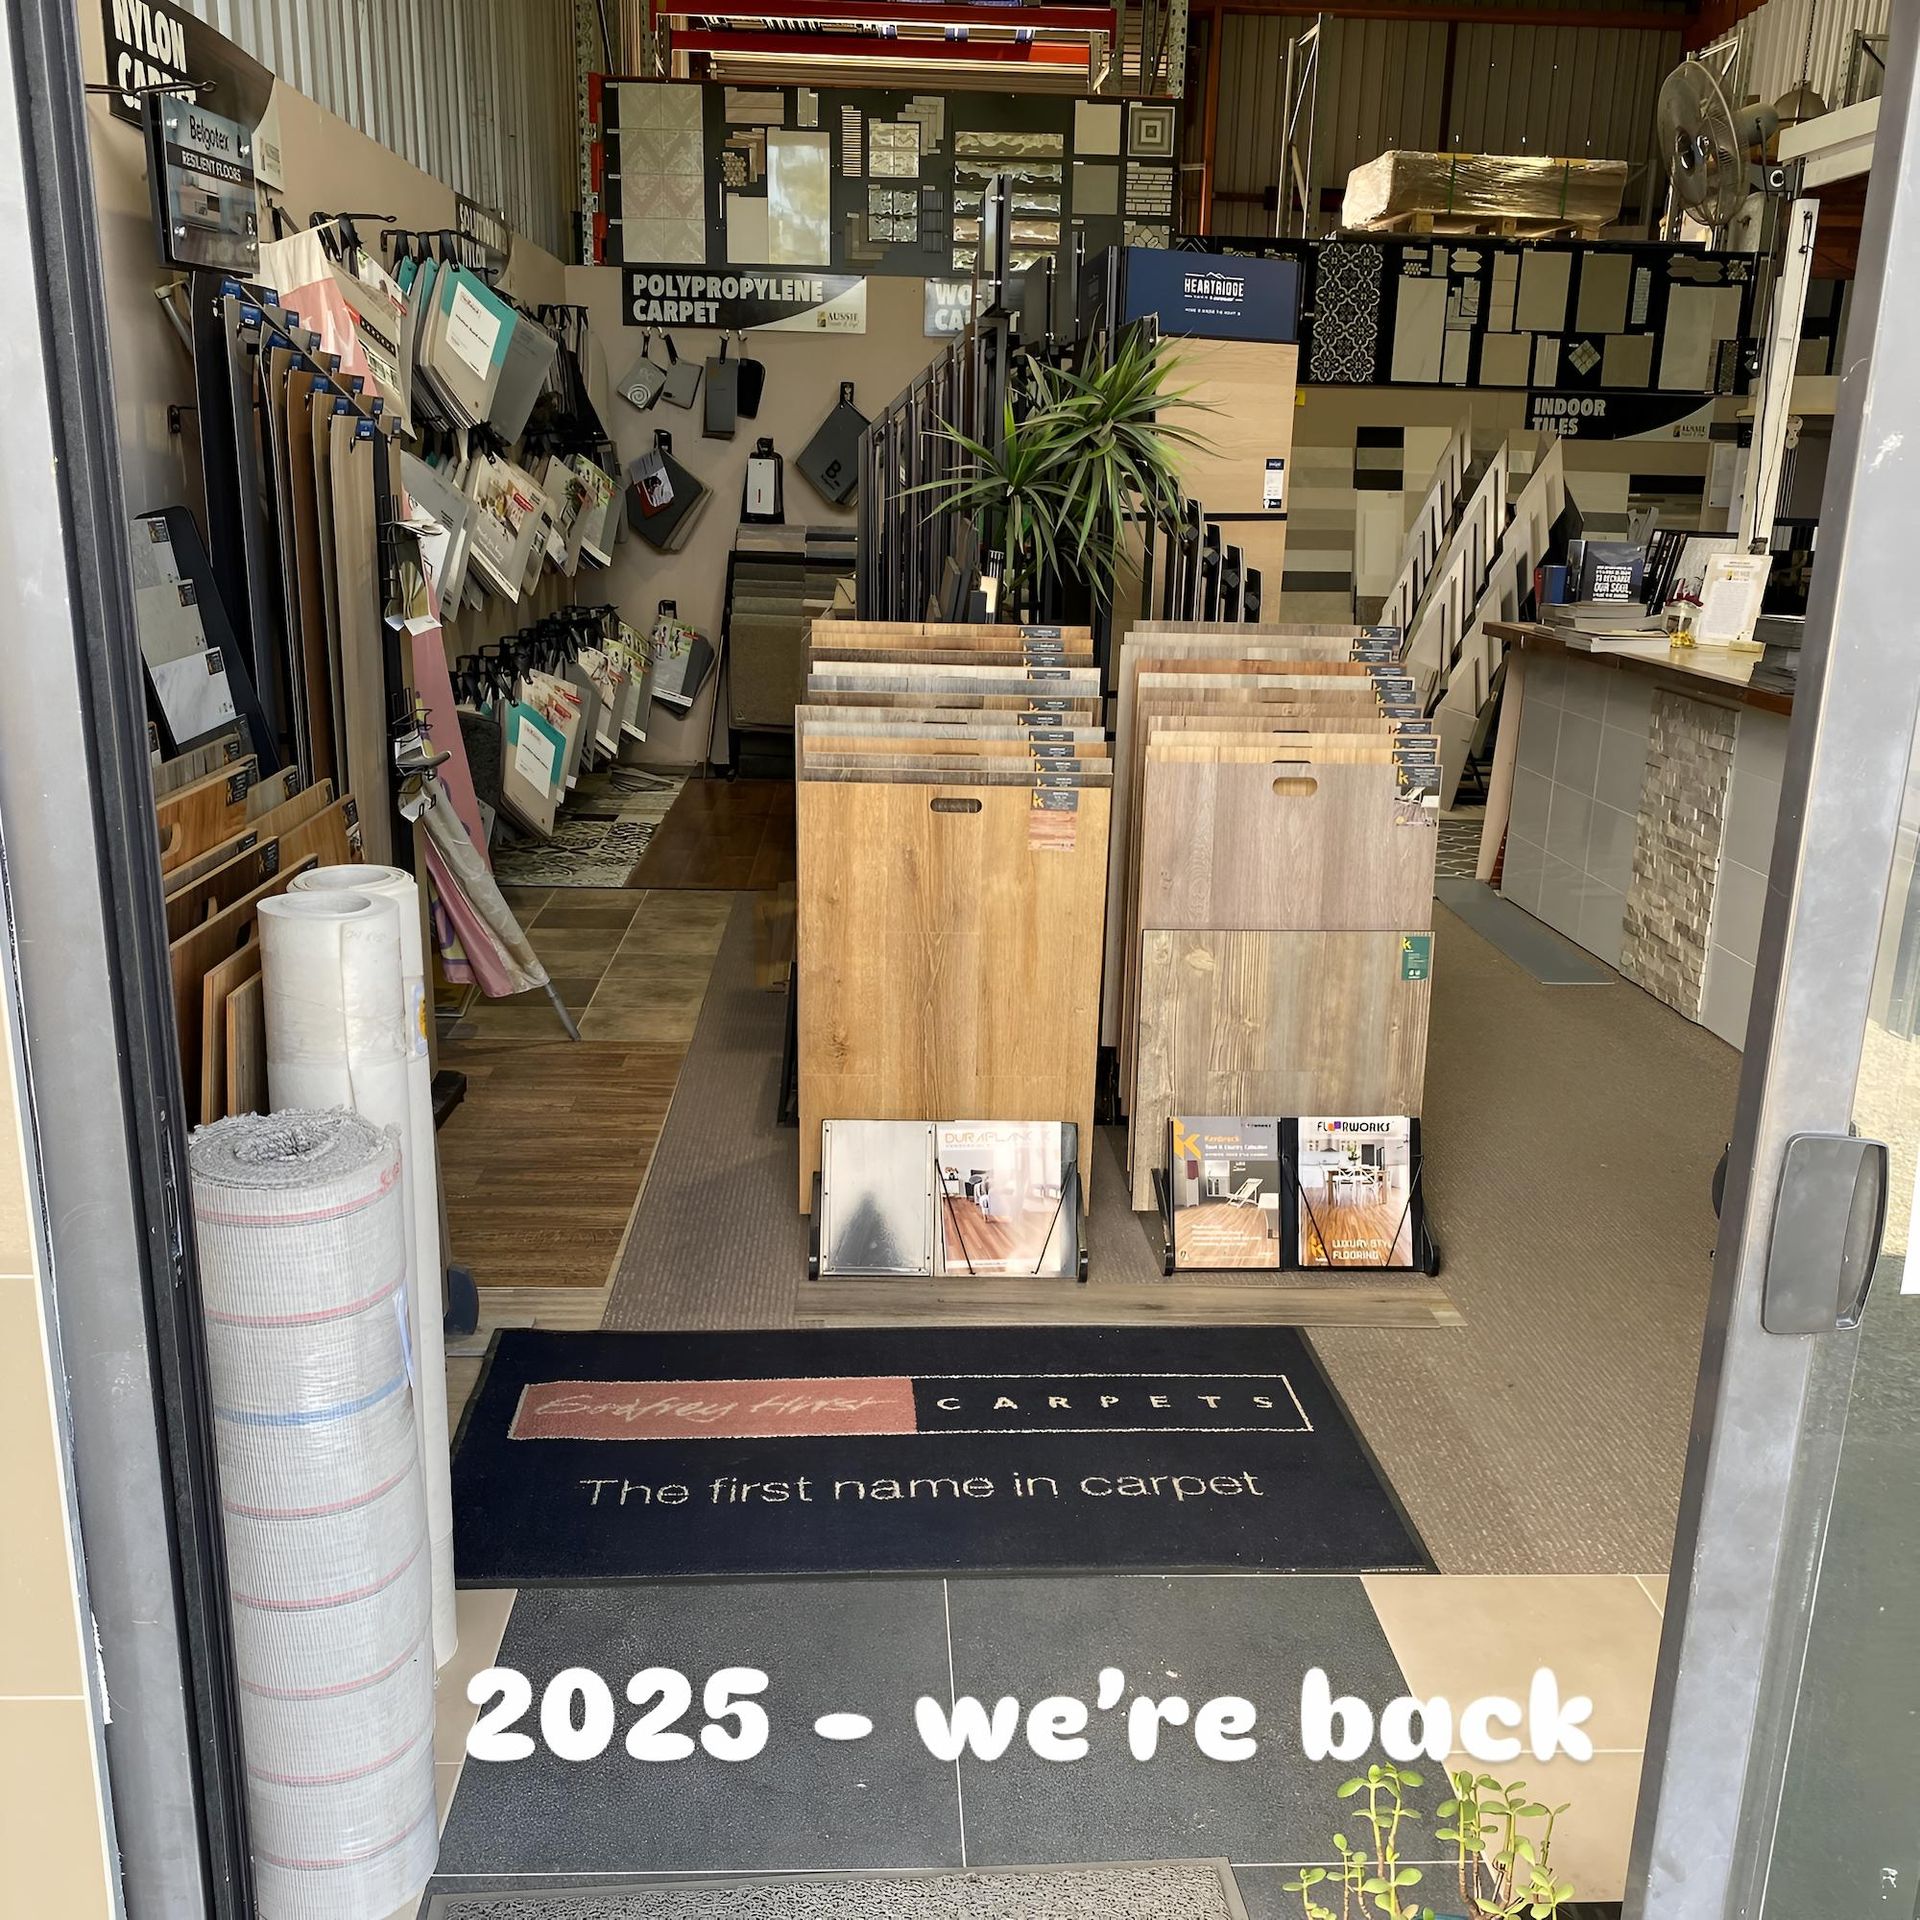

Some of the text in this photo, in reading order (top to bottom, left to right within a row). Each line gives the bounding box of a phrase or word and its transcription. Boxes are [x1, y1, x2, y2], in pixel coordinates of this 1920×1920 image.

[112, 0, 188, 73] NYLON
[632, 274, 823, 303] POLYPROPYLENE
[1184, 278, 1245, 297] HEARTRIDGE
[632, 299, 719, 324] CARPET
[1534, 397, 1606, 417] INDOOR
[1532, 417, 1579, 435] TILES
[579, 1470, 1265, 1505] The first name in carpet
